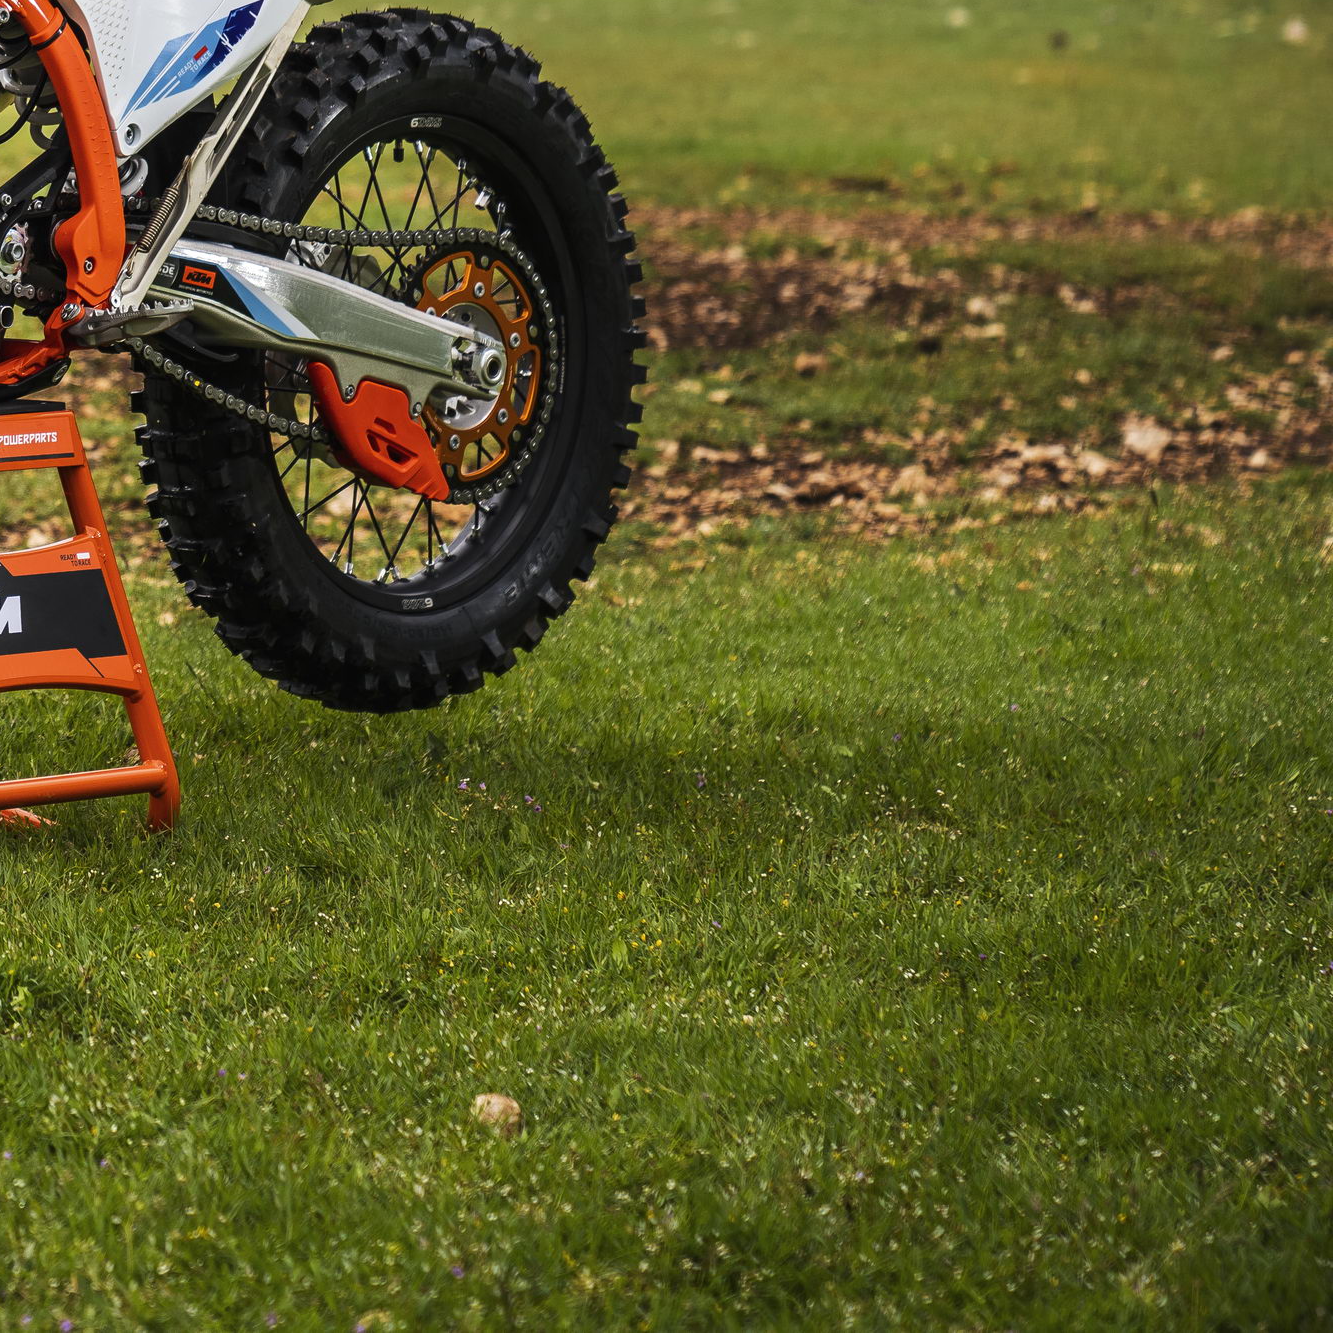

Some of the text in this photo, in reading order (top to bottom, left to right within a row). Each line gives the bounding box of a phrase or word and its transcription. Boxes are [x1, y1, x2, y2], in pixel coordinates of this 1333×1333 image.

[177, 59, 195, 78] READY
[190, 50, 212, 73] TO RACE
[185, 272, 212, 284] KTM
[60, 553, 77, 561] READY
